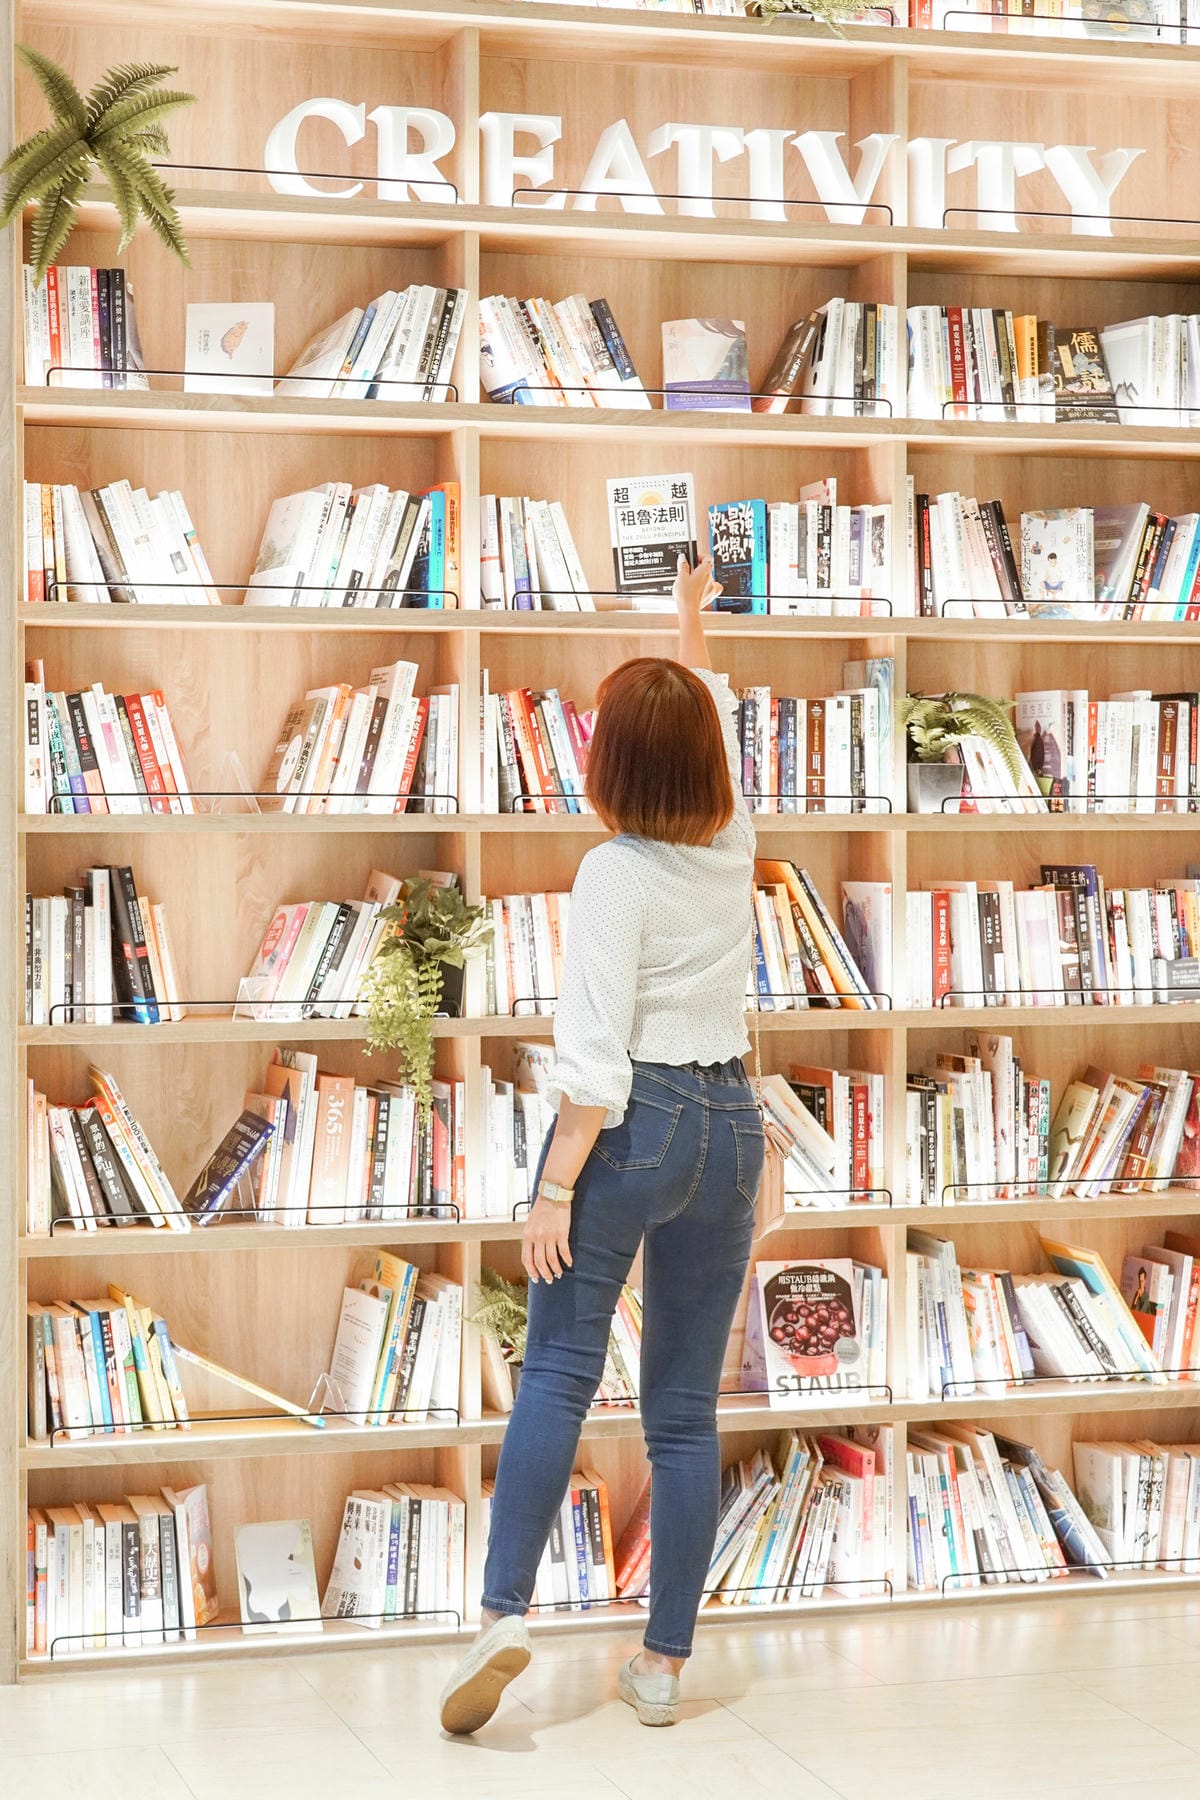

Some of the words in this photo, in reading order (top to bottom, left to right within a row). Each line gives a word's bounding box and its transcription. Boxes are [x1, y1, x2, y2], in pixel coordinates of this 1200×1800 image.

[264, 97, 1147, 237] CREATIVITY
[613, 487, 630, 504] 超
[671, 482, 688, 500] 越
[619, 505, 685, 527] 祖魯法則
[652, 530, 686, 539] PRINCIPLE
[326, 1094, 346, 1135] 365
[776, 1371, 862, 1398] STAUB
